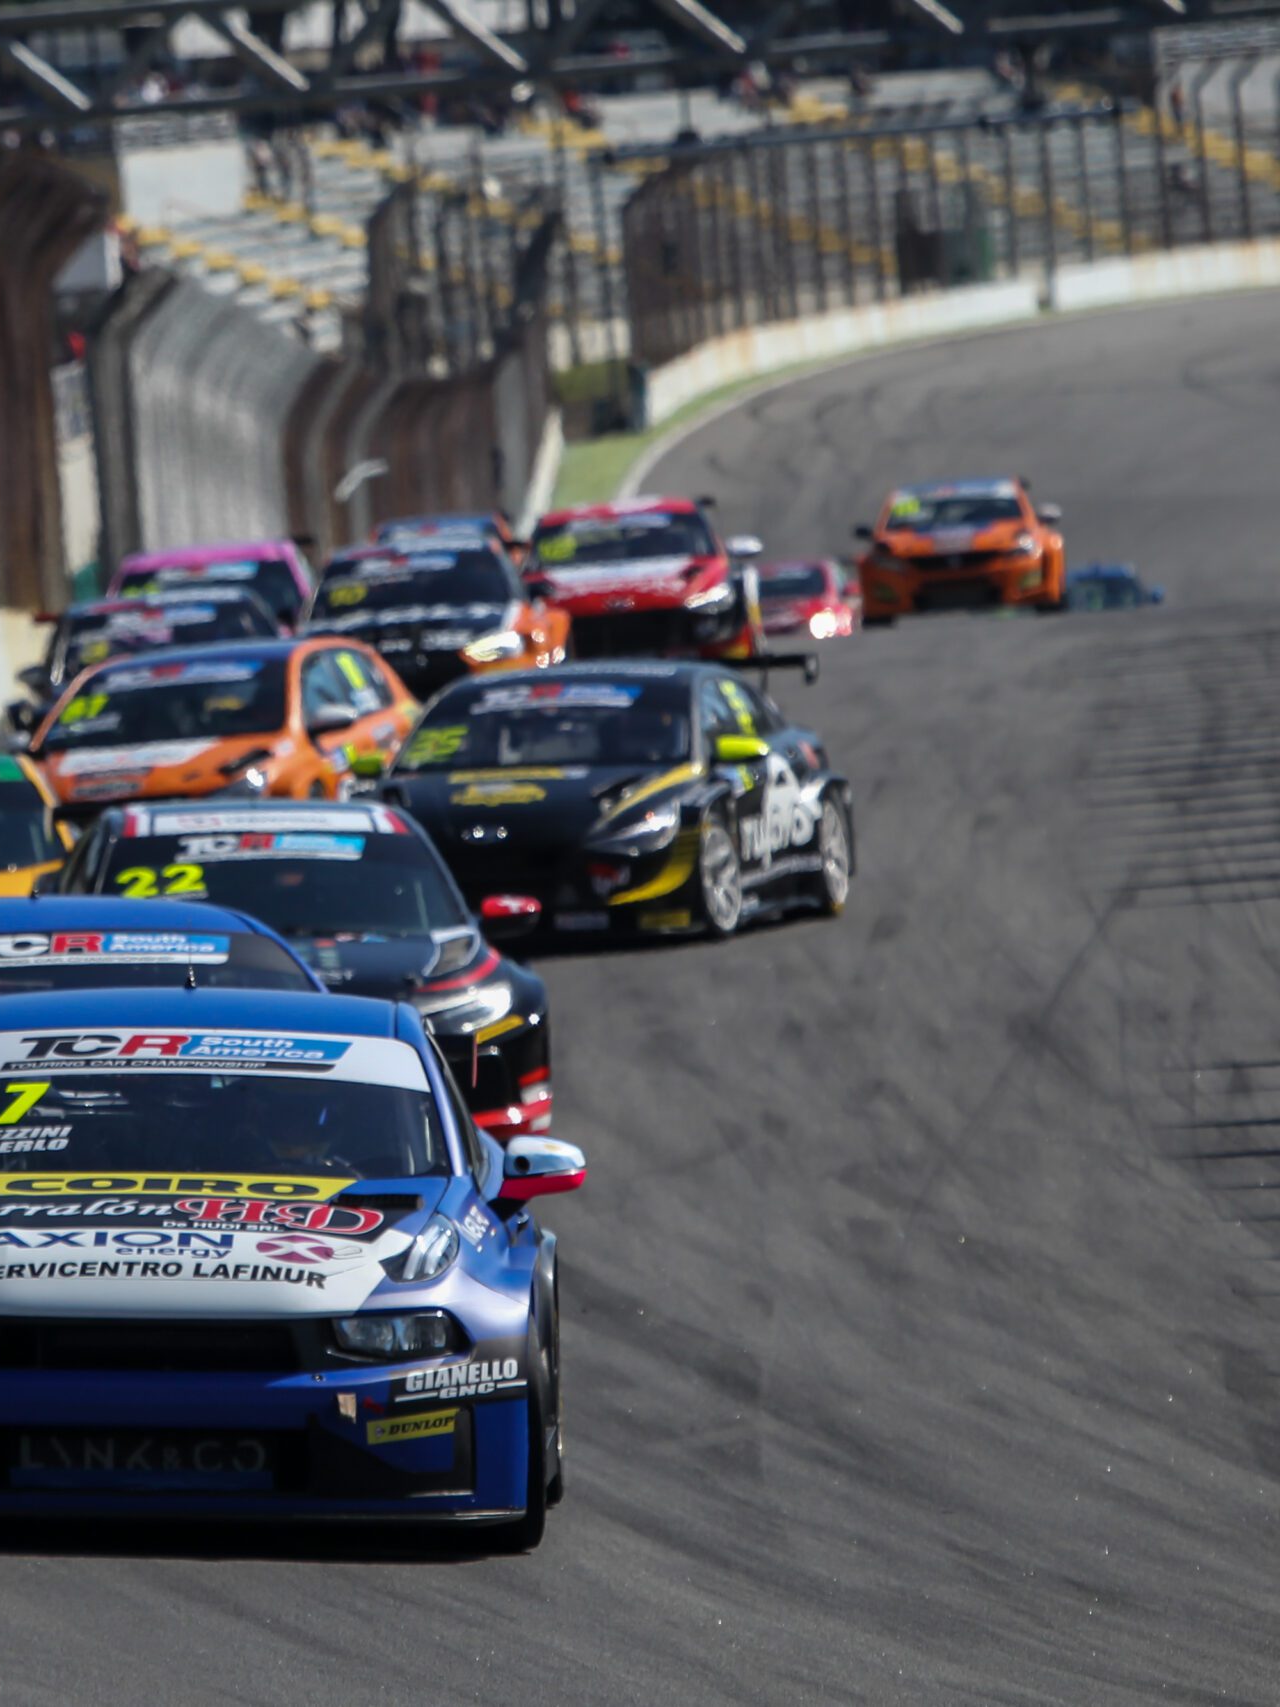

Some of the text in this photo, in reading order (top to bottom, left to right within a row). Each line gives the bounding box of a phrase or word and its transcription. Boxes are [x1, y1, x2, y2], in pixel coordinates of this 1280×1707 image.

[116, 863, 207, 899] 22
[108, 942, 215, 954] America
[111, 934, 187, 944] South
[21, 1035, 191, 1059] TCR
[201, 1036, 294, 1049] South
[191, 1046, 324, 1060] America
[9, 1059, 266, 1070] TOURING CAR CHAMPIONSHIP
[5, 1177, 320, 1198] COIRO
[114, 1246, 232, 1259] energy
[192, 1262, 326, 1290] LAFINUR
[405, 1359, 519, 1393] GIANELLO
[439, 1381, 496, 1400] GNC
[388, 1416, 455, 1437] DUNLOP
